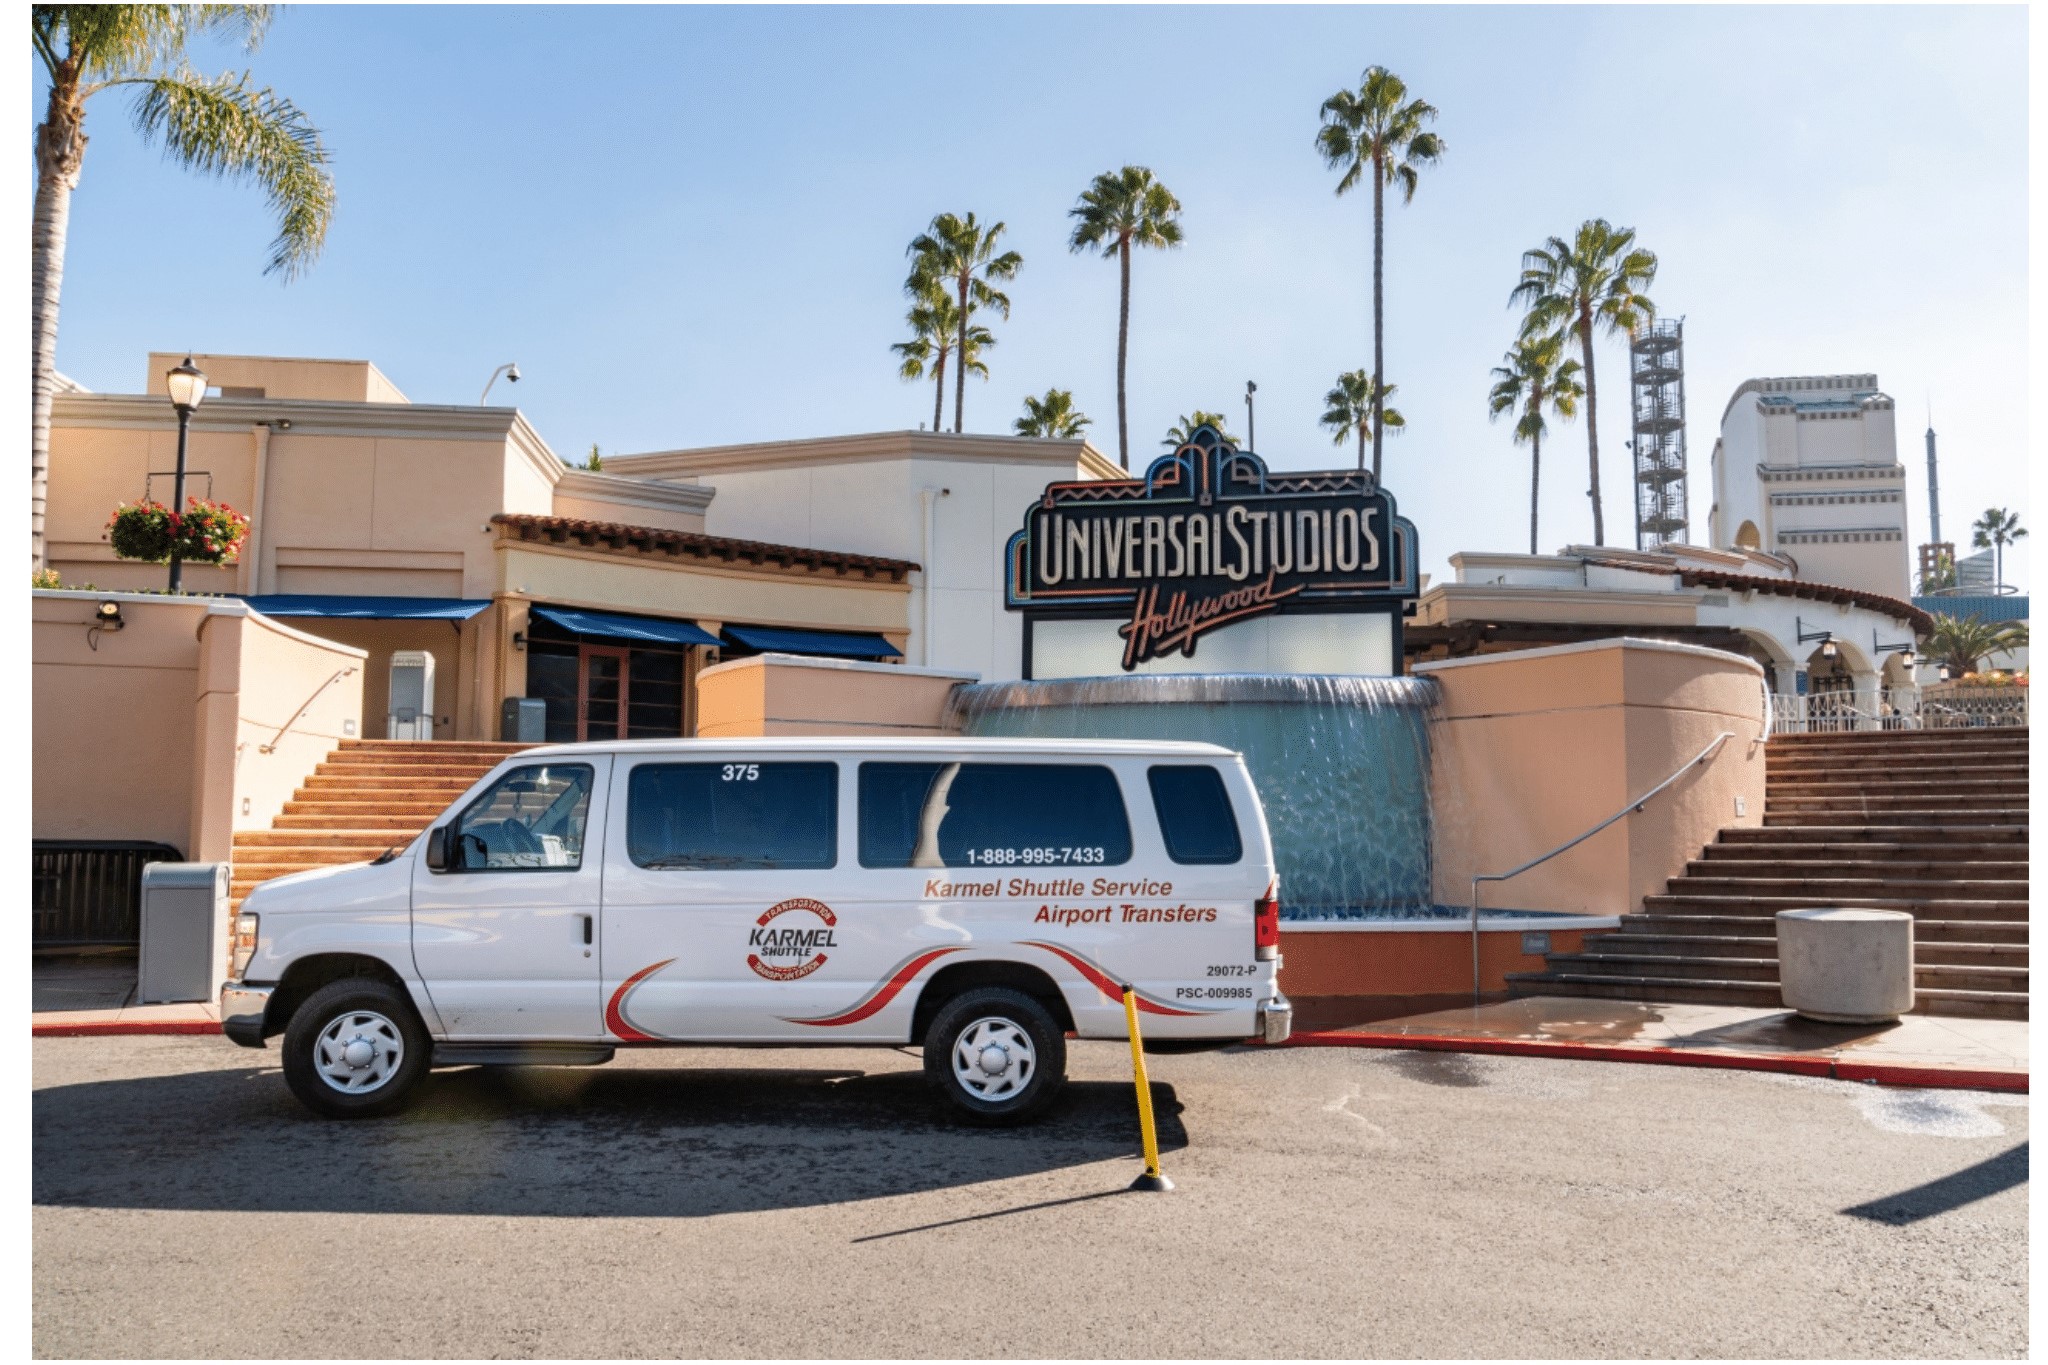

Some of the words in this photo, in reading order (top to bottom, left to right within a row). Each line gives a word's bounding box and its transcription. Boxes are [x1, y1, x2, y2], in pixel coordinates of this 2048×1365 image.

[1039, 512, 1230, 585] UNIVERSAL
[1225, 505, 1380, 581] STUDIOS
[1119, 564, 1306, 670] Hollywood
[721, 764, 760, 781] 375
[967, 847, 1105, 865] 1-888-995-7433
[924, 879, 1001, 898] Karmel
[1007, 878, 1085, 898] Shuttle
[1091, 878, 1173, 897] Service
[765, 900, 832, 920] TRANSPORTATION
[1034, 905, 1112, 927] Airport
[1119, 904, 1217, 923] Transfers
[748, 928, 838, 947] KARMEL
[761, 947, 812, 957] SHUTTLE
[1206, 965, 1257, 976] 29072-P
[1176, 987, 1253, 998] PSC-009985
